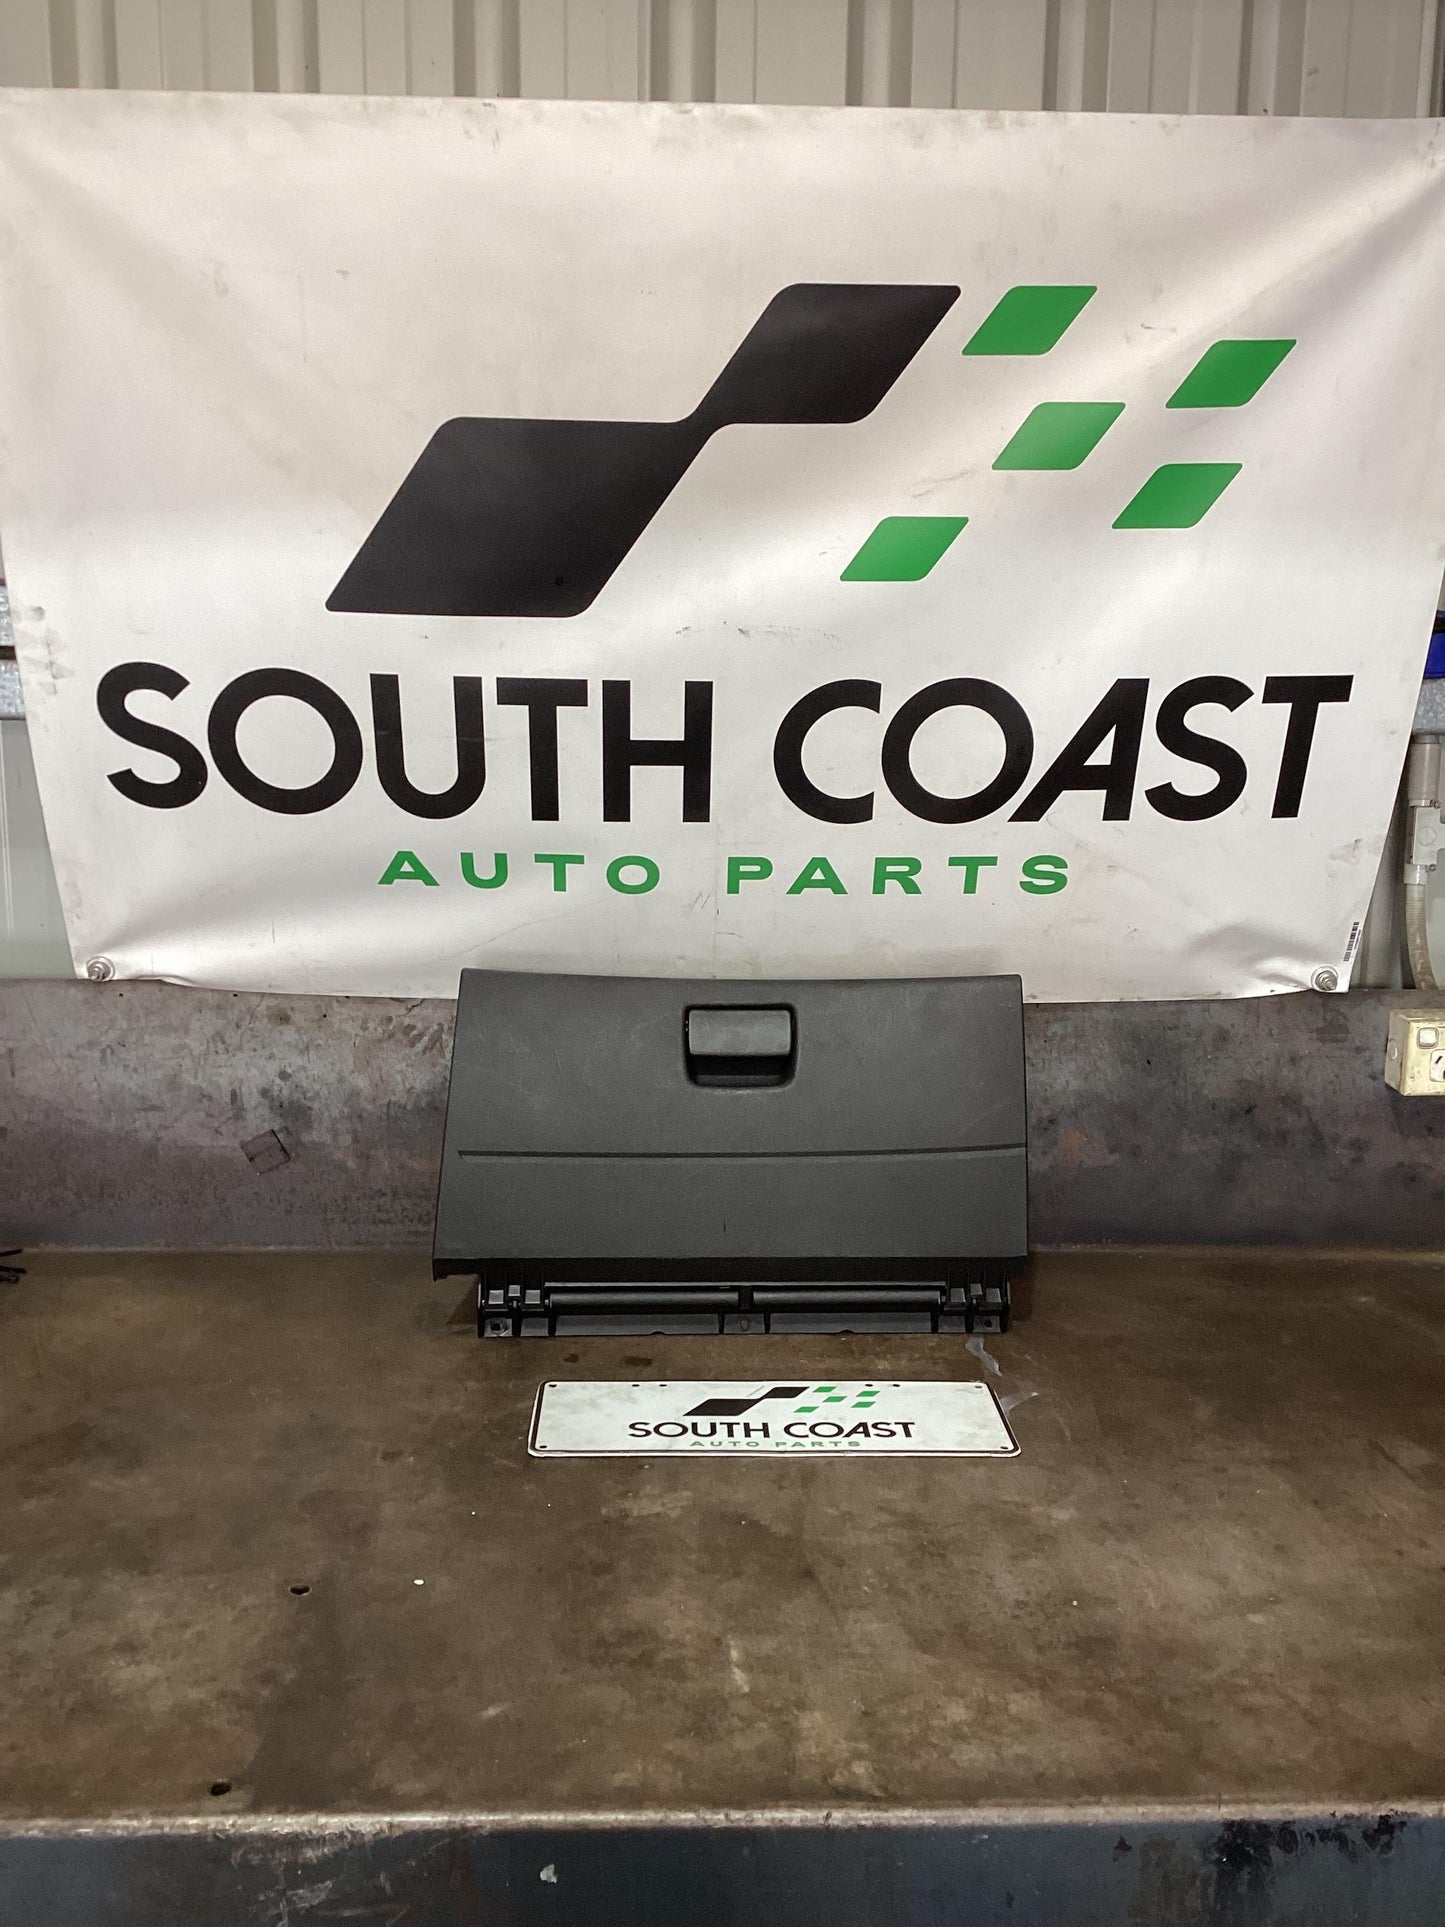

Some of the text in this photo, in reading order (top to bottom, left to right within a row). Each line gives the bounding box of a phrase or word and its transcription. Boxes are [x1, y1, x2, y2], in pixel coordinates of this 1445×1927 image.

[96, 661, 1354, 825] SOUTH COAST
[379, 850, 1069, 895] AUTO PARTS
[628, 1421, 915, 1439] SOUTH COAST
[689, 1440, 862, 1448] AUTO PARTS
